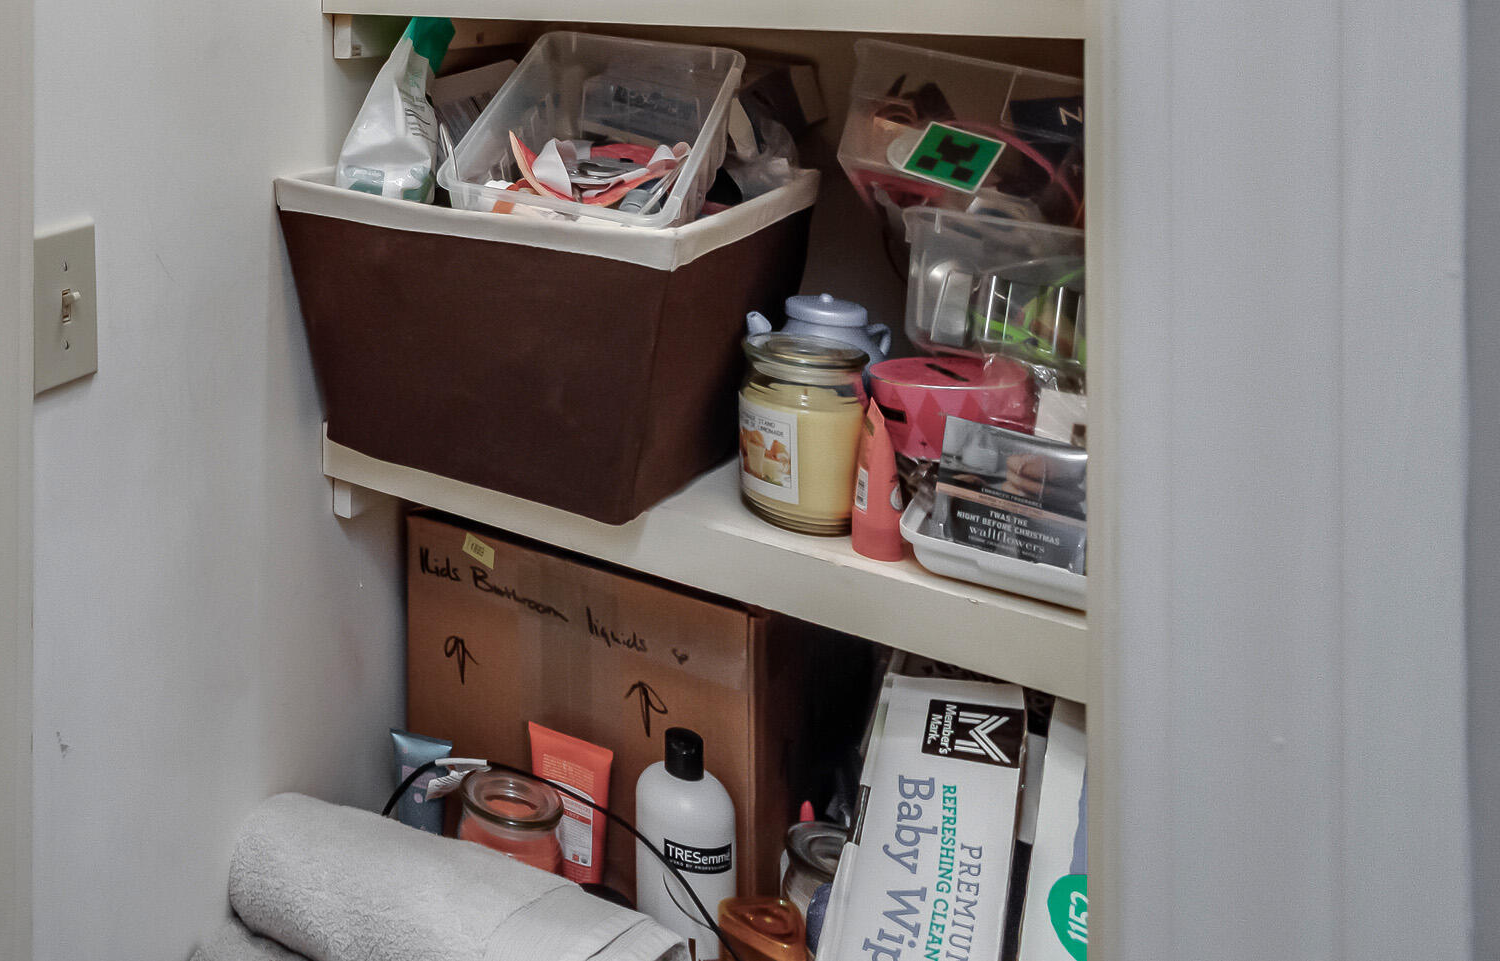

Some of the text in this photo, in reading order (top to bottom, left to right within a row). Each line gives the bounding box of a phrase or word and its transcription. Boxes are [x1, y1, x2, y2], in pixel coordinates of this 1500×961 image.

[957, 510, 1060, 546] NIGHT BEFORE CHRISTMAS
[969, 525, 1045, 553] wallflowers
[1013, 516, 1029, 528] THE
[419, 546, 462, 581] Kids
[586, 606, 647, 652] liquids
[938, 703, 958, 755] Member's
[882, 774, 939, 875] Baby
[935, 783, 957, 895] REFRESHING
[946, 842, 983, 961] PREMIU
